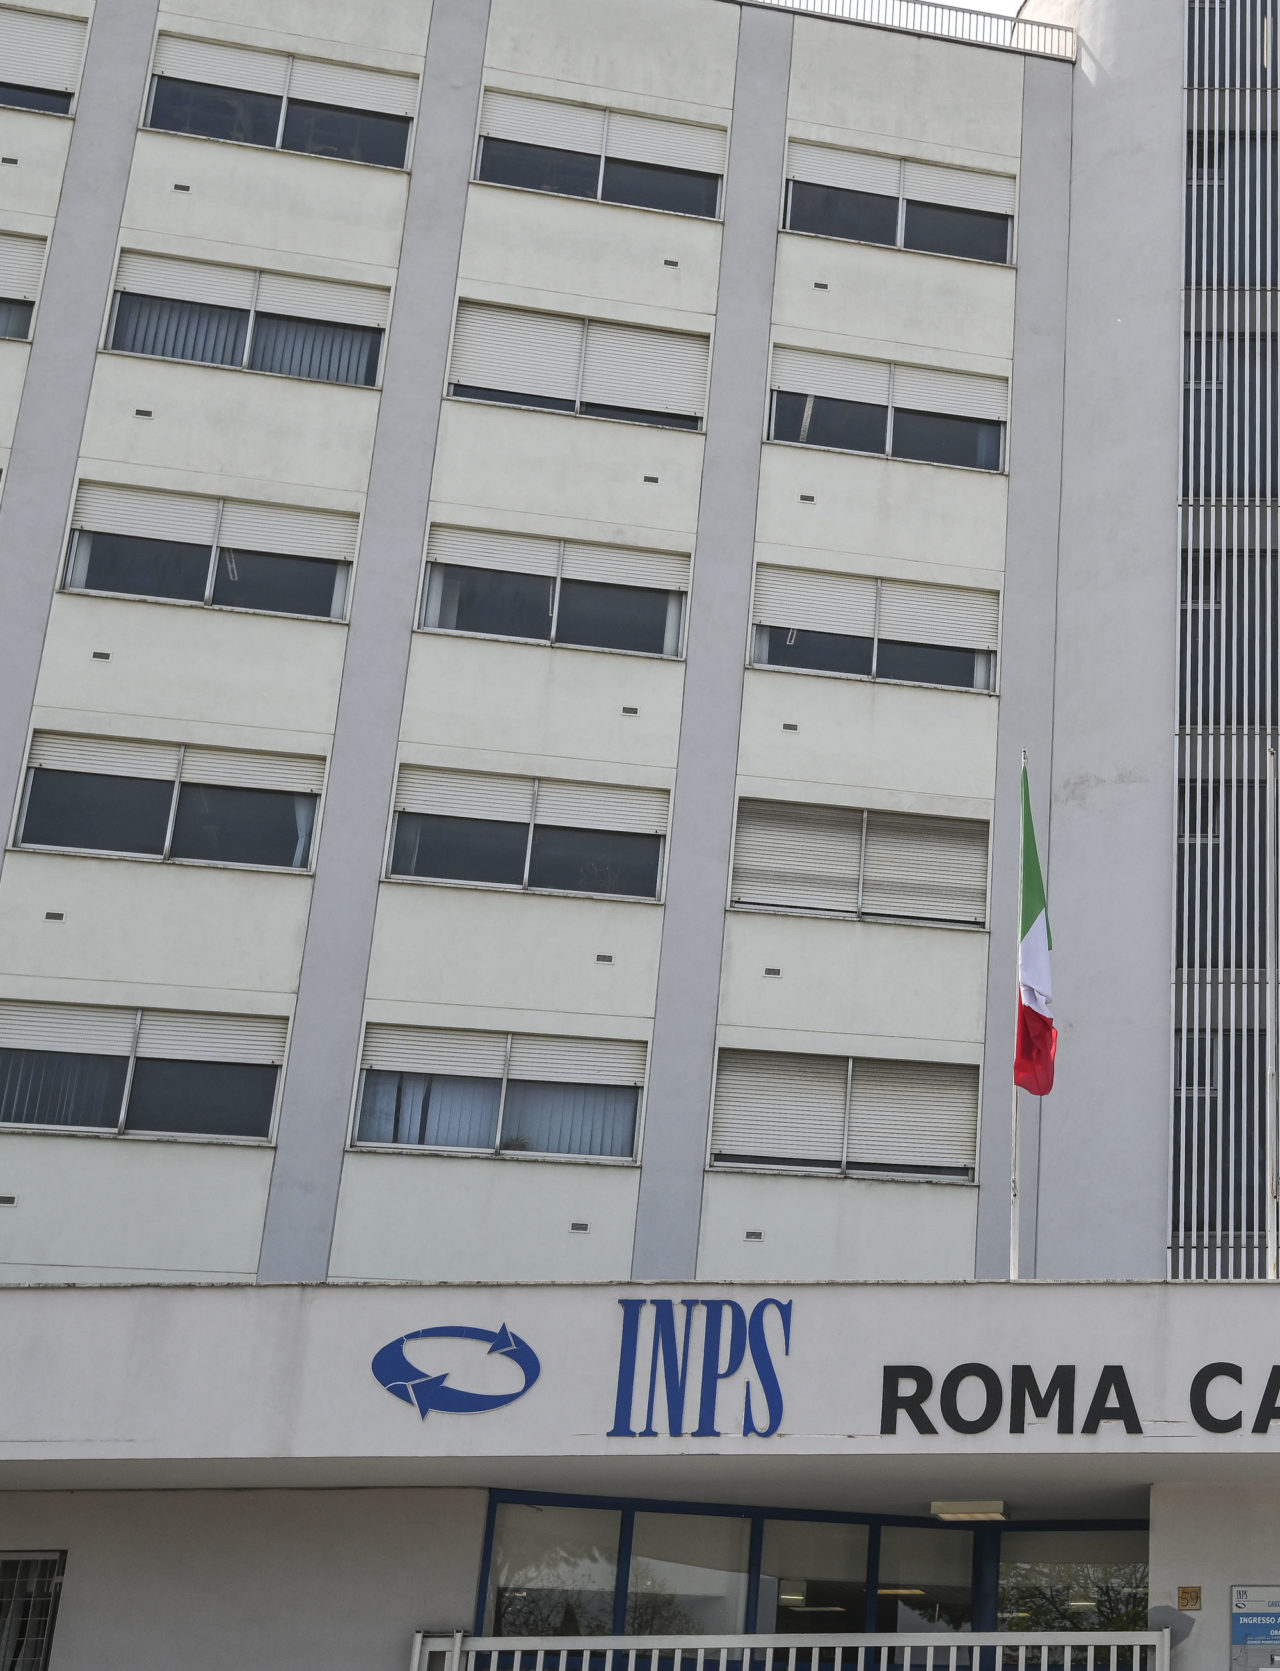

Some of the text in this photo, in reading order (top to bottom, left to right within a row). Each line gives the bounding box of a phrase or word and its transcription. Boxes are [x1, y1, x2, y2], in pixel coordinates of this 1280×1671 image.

[606, 1297, 793, 1439] INPS
[880, 1362, 1144, 1436] ROMA
[1181, 1591, 1199, 1607] 59
[1236, 1589, 1248, 1599] INPS
[1239, 1616, 1275, 1624] INGRESSO
